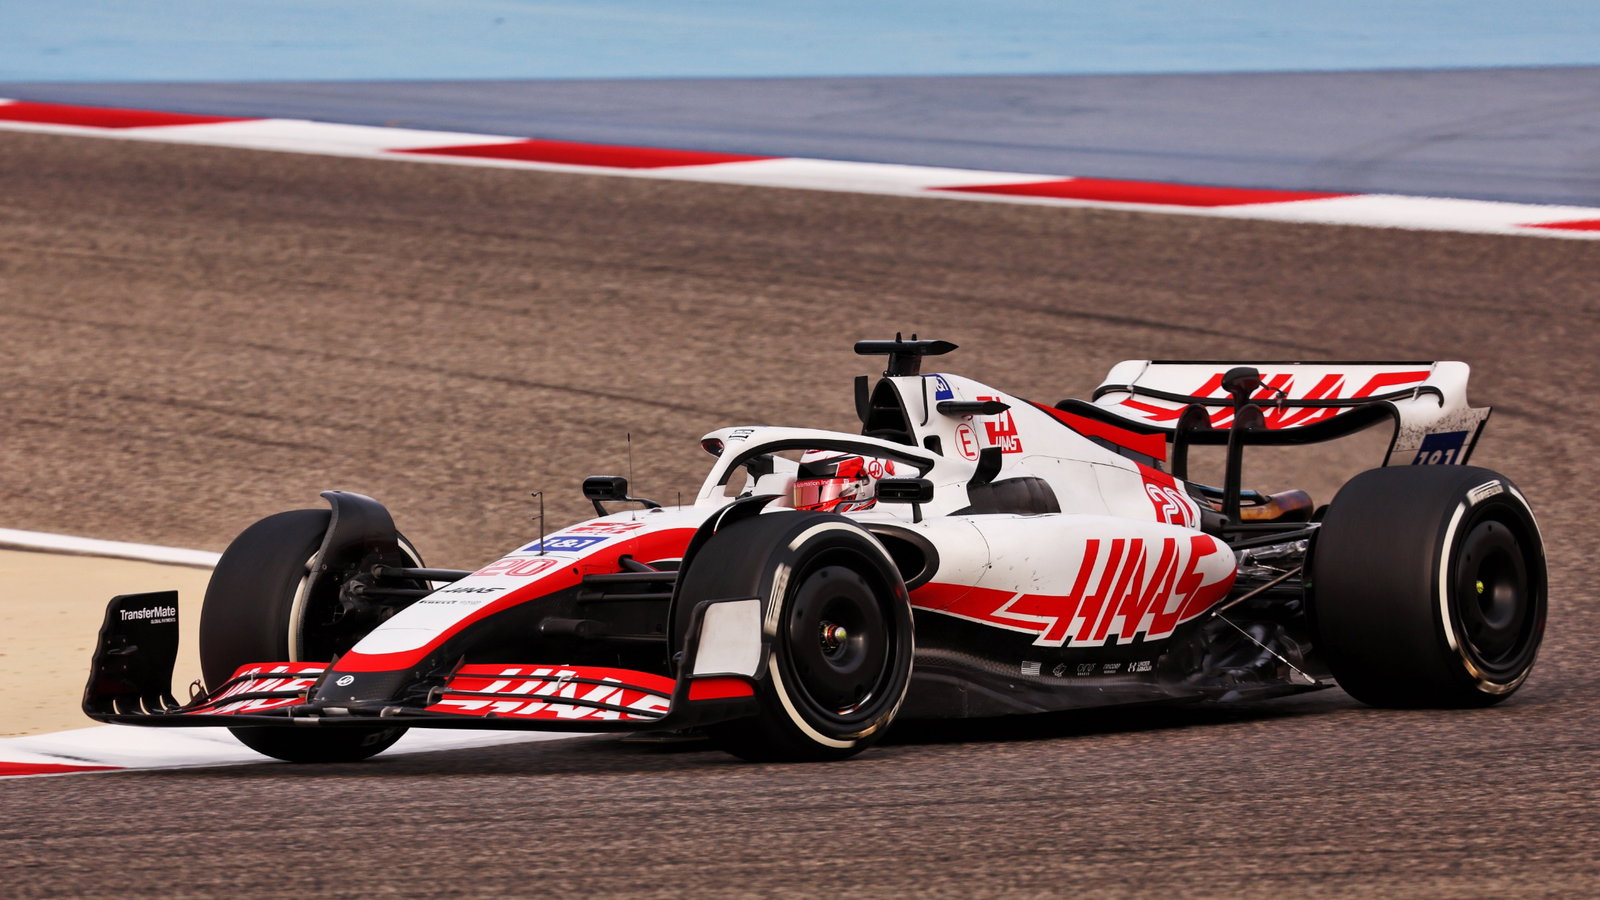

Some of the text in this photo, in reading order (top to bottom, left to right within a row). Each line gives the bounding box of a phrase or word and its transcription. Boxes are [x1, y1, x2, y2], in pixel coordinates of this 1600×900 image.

[960, 429, 976, 457] E
[471, 558, 558, 577] 20
[991, 534, 1228, 646] HAAS
[120, 606, 176, 621] TransferMate
[436, 668, 672, 720] HAAS
